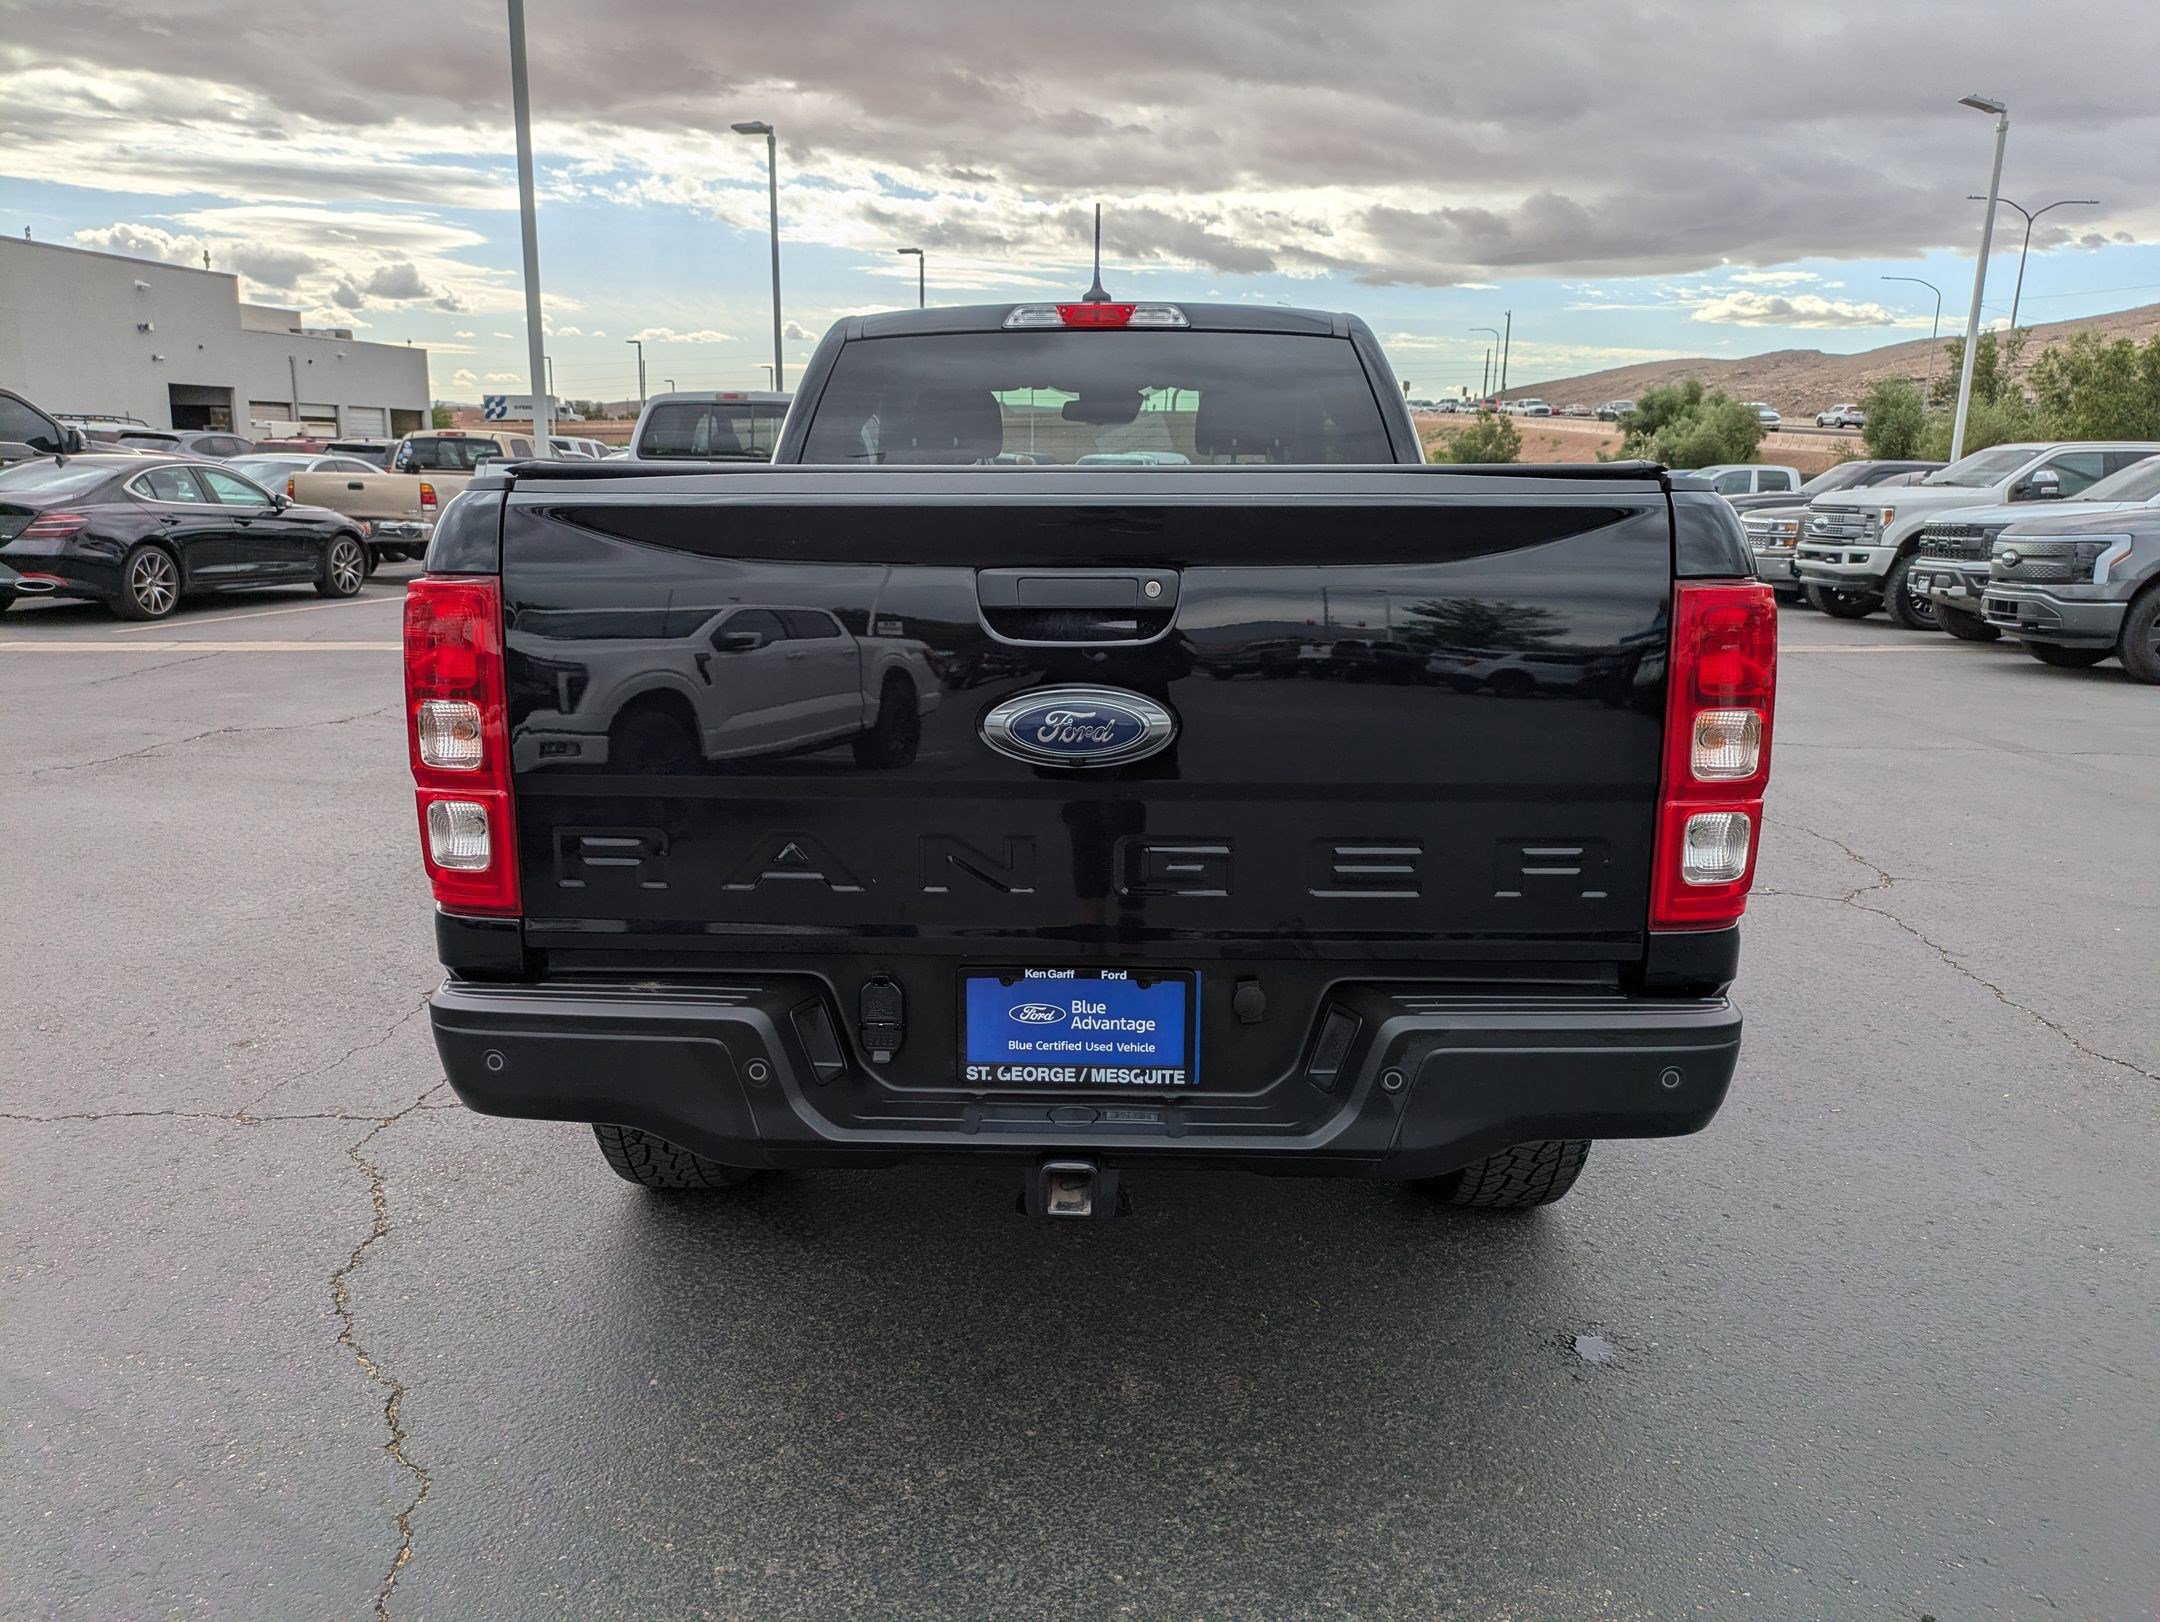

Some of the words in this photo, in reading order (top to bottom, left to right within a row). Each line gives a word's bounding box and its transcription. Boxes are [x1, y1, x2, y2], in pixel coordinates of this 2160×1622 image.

[1037, 710, 1116, 743] Ford
[552, 825, 1610, 899] RANGER
[1024, 968, 1047, 979] Ken
[1047, 969, 1075, 980] Garff
[1101, 970, 1127, 981] Ford
[1019, 1004, 1055, 1022] Ford
[1071, 1000, 1107, 1015] Blue
[1070, 1016, 1156, 1034] Advantage
[1008, 1040, 1033, 1051] Blue
[1036, 1040, 1082, 1052] Certified
[1085, 1042, 1114, 1052] Used
[1117, 1042, 1156, 1053] Vehicle
[966, 1066, 993, 1081] ST.
[997, 1066, 1076, 1082] GEORGE
[1091, 1068, 1186, 1085] MESQUITE
